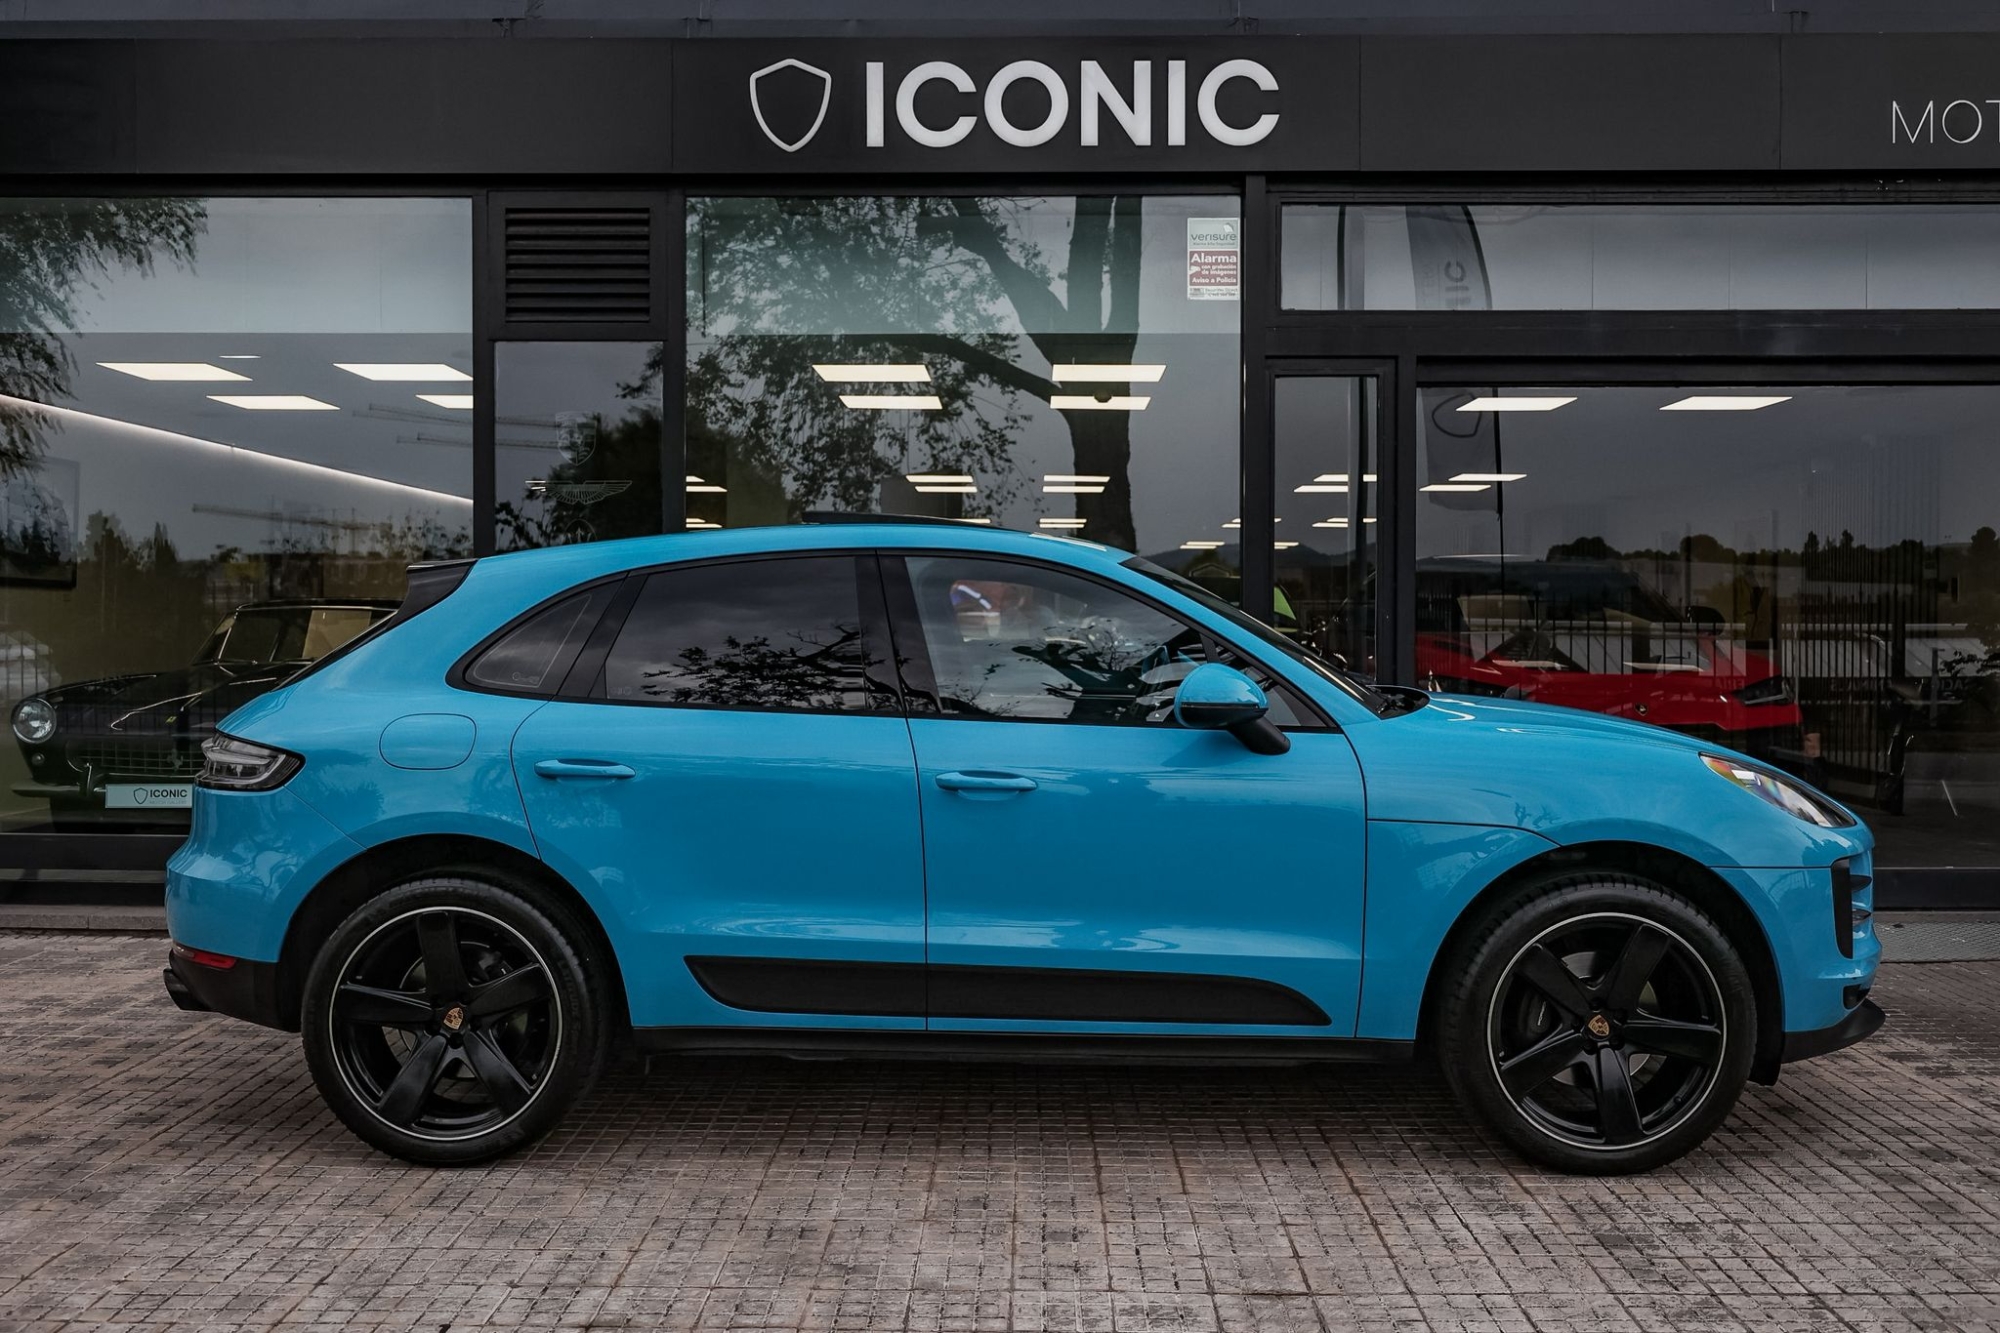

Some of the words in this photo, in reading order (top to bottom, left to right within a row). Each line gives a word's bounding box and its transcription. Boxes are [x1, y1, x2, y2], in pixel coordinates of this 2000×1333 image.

[866, 59, 1280, 147] ICONIC
[1191, 233, 1237, 241] verisure
[1191, 252, 1237, 263] Alarma
[150, 789, 187, 798] ICONIC
